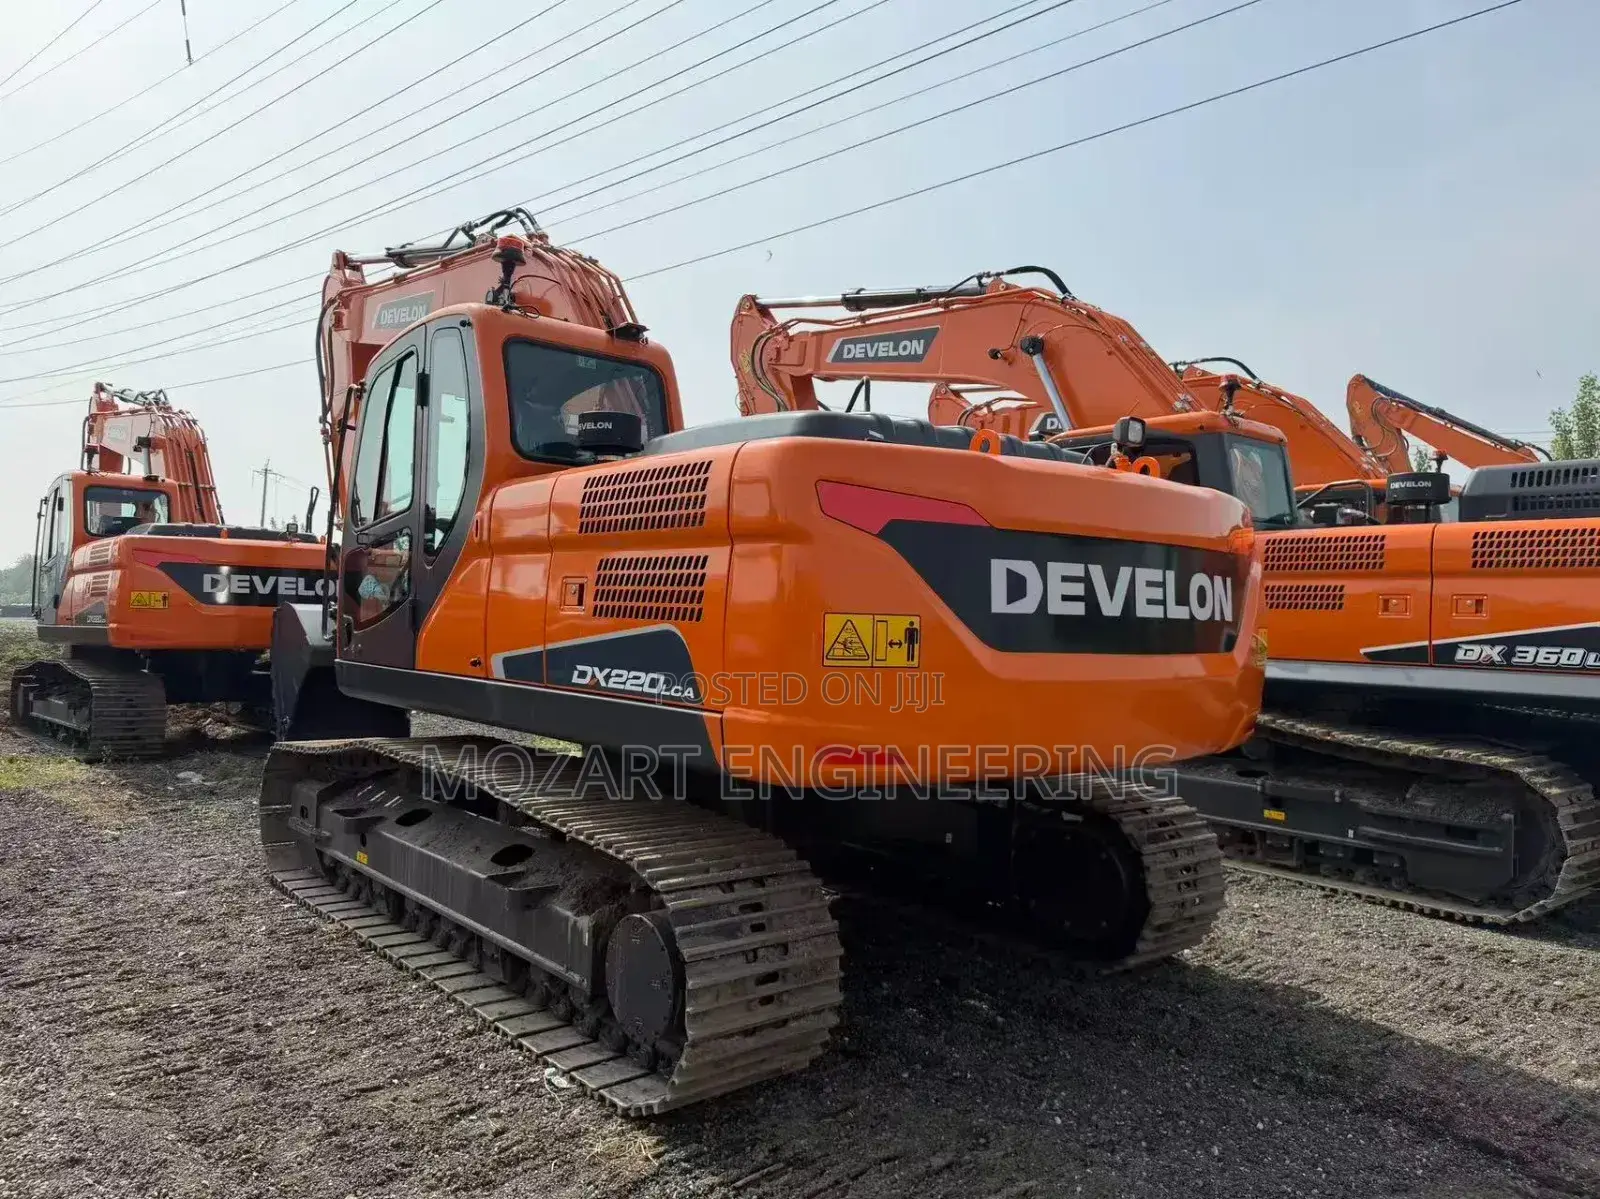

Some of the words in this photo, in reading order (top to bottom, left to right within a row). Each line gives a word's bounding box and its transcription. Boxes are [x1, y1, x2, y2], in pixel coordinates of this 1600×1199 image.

[380, 304, 427, 326] DEVELON
[843, 340, 924, 358] DEVELON
[1390, 480, 1432, 489] DEVELON
[203, 573, 339, 596] DEVELO
[990, 558, 1233, 622] DEVELON
